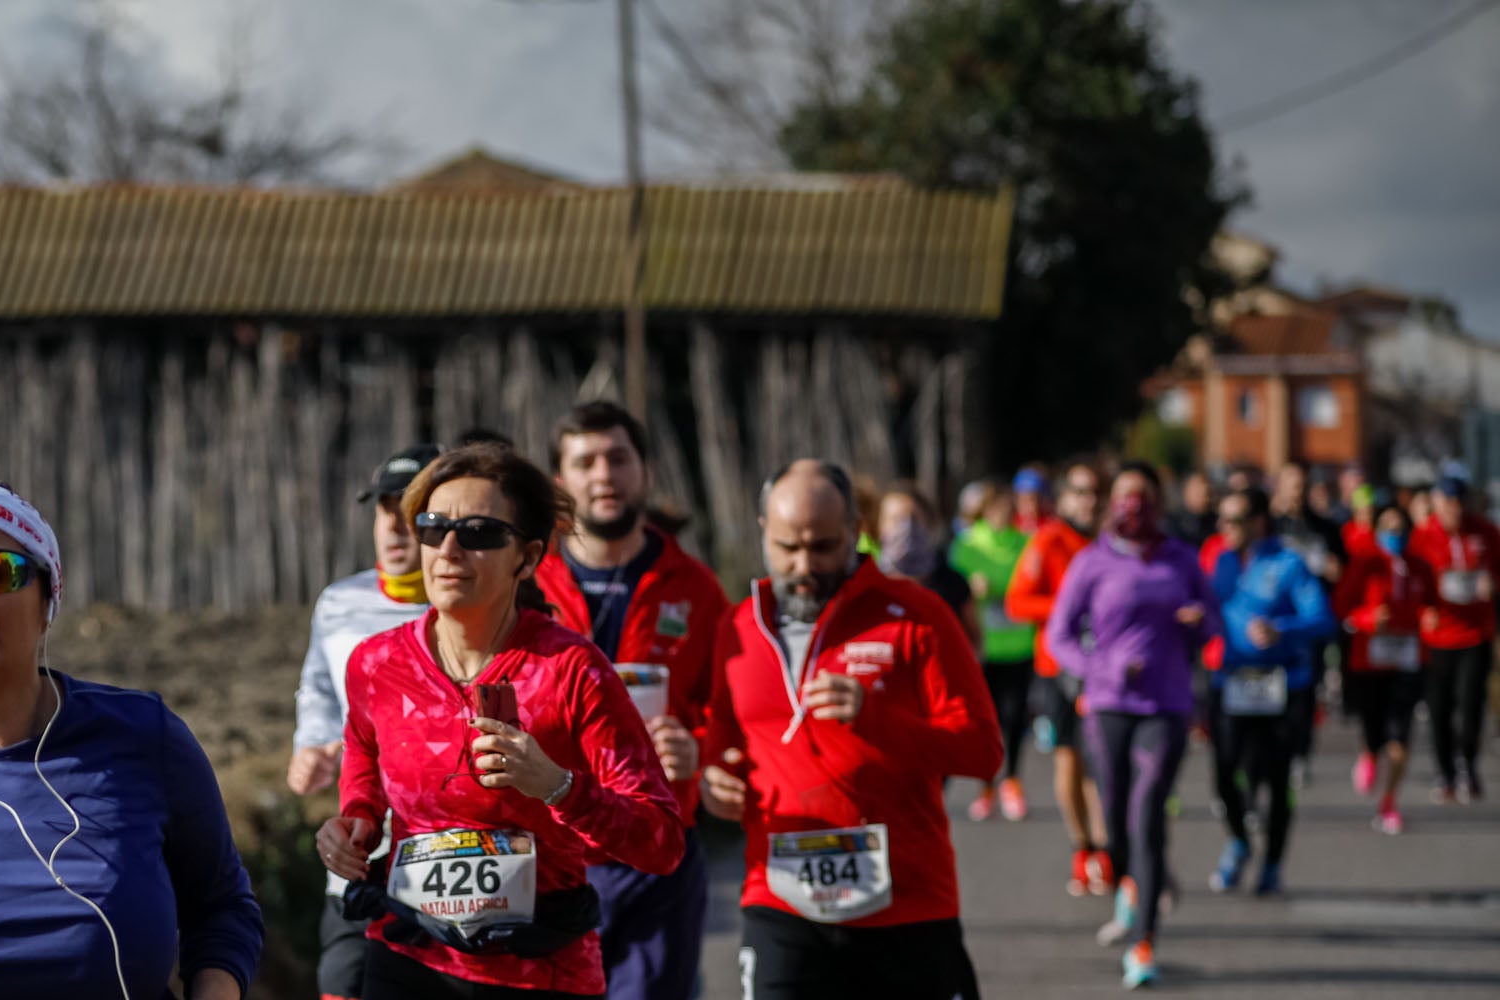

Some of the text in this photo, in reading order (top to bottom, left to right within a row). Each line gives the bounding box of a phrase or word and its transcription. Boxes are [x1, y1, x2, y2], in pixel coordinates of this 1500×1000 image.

[422, 859, 501, 898] 426
[799, 854, 860, 887] 484
[419, 901, 466, 917] NATALIA
